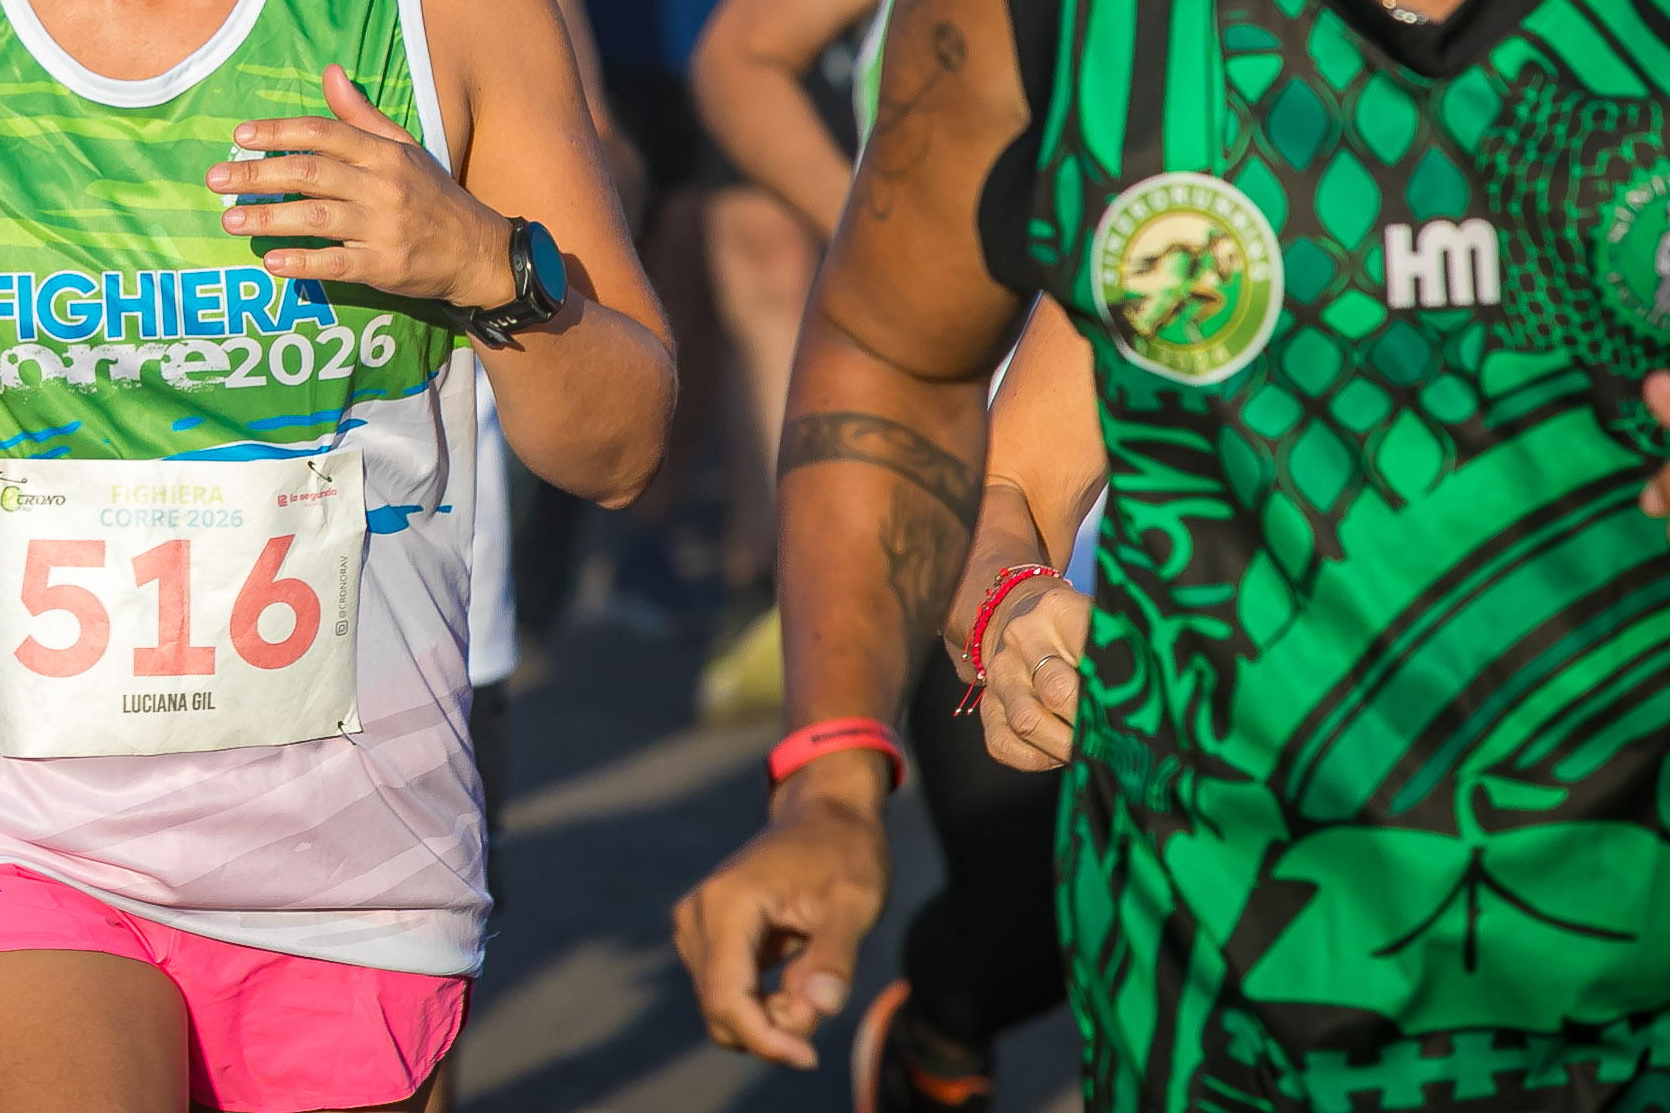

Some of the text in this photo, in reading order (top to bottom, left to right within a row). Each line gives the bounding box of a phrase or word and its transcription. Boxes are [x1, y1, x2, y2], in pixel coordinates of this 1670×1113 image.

[112, 485, 225, 505] FIGHIERA
[99, 508, 244, 528] CORRE 2026
[14, 534, 321, 678] 516
[123, 691, 216, 713] LUCIANA GIL
